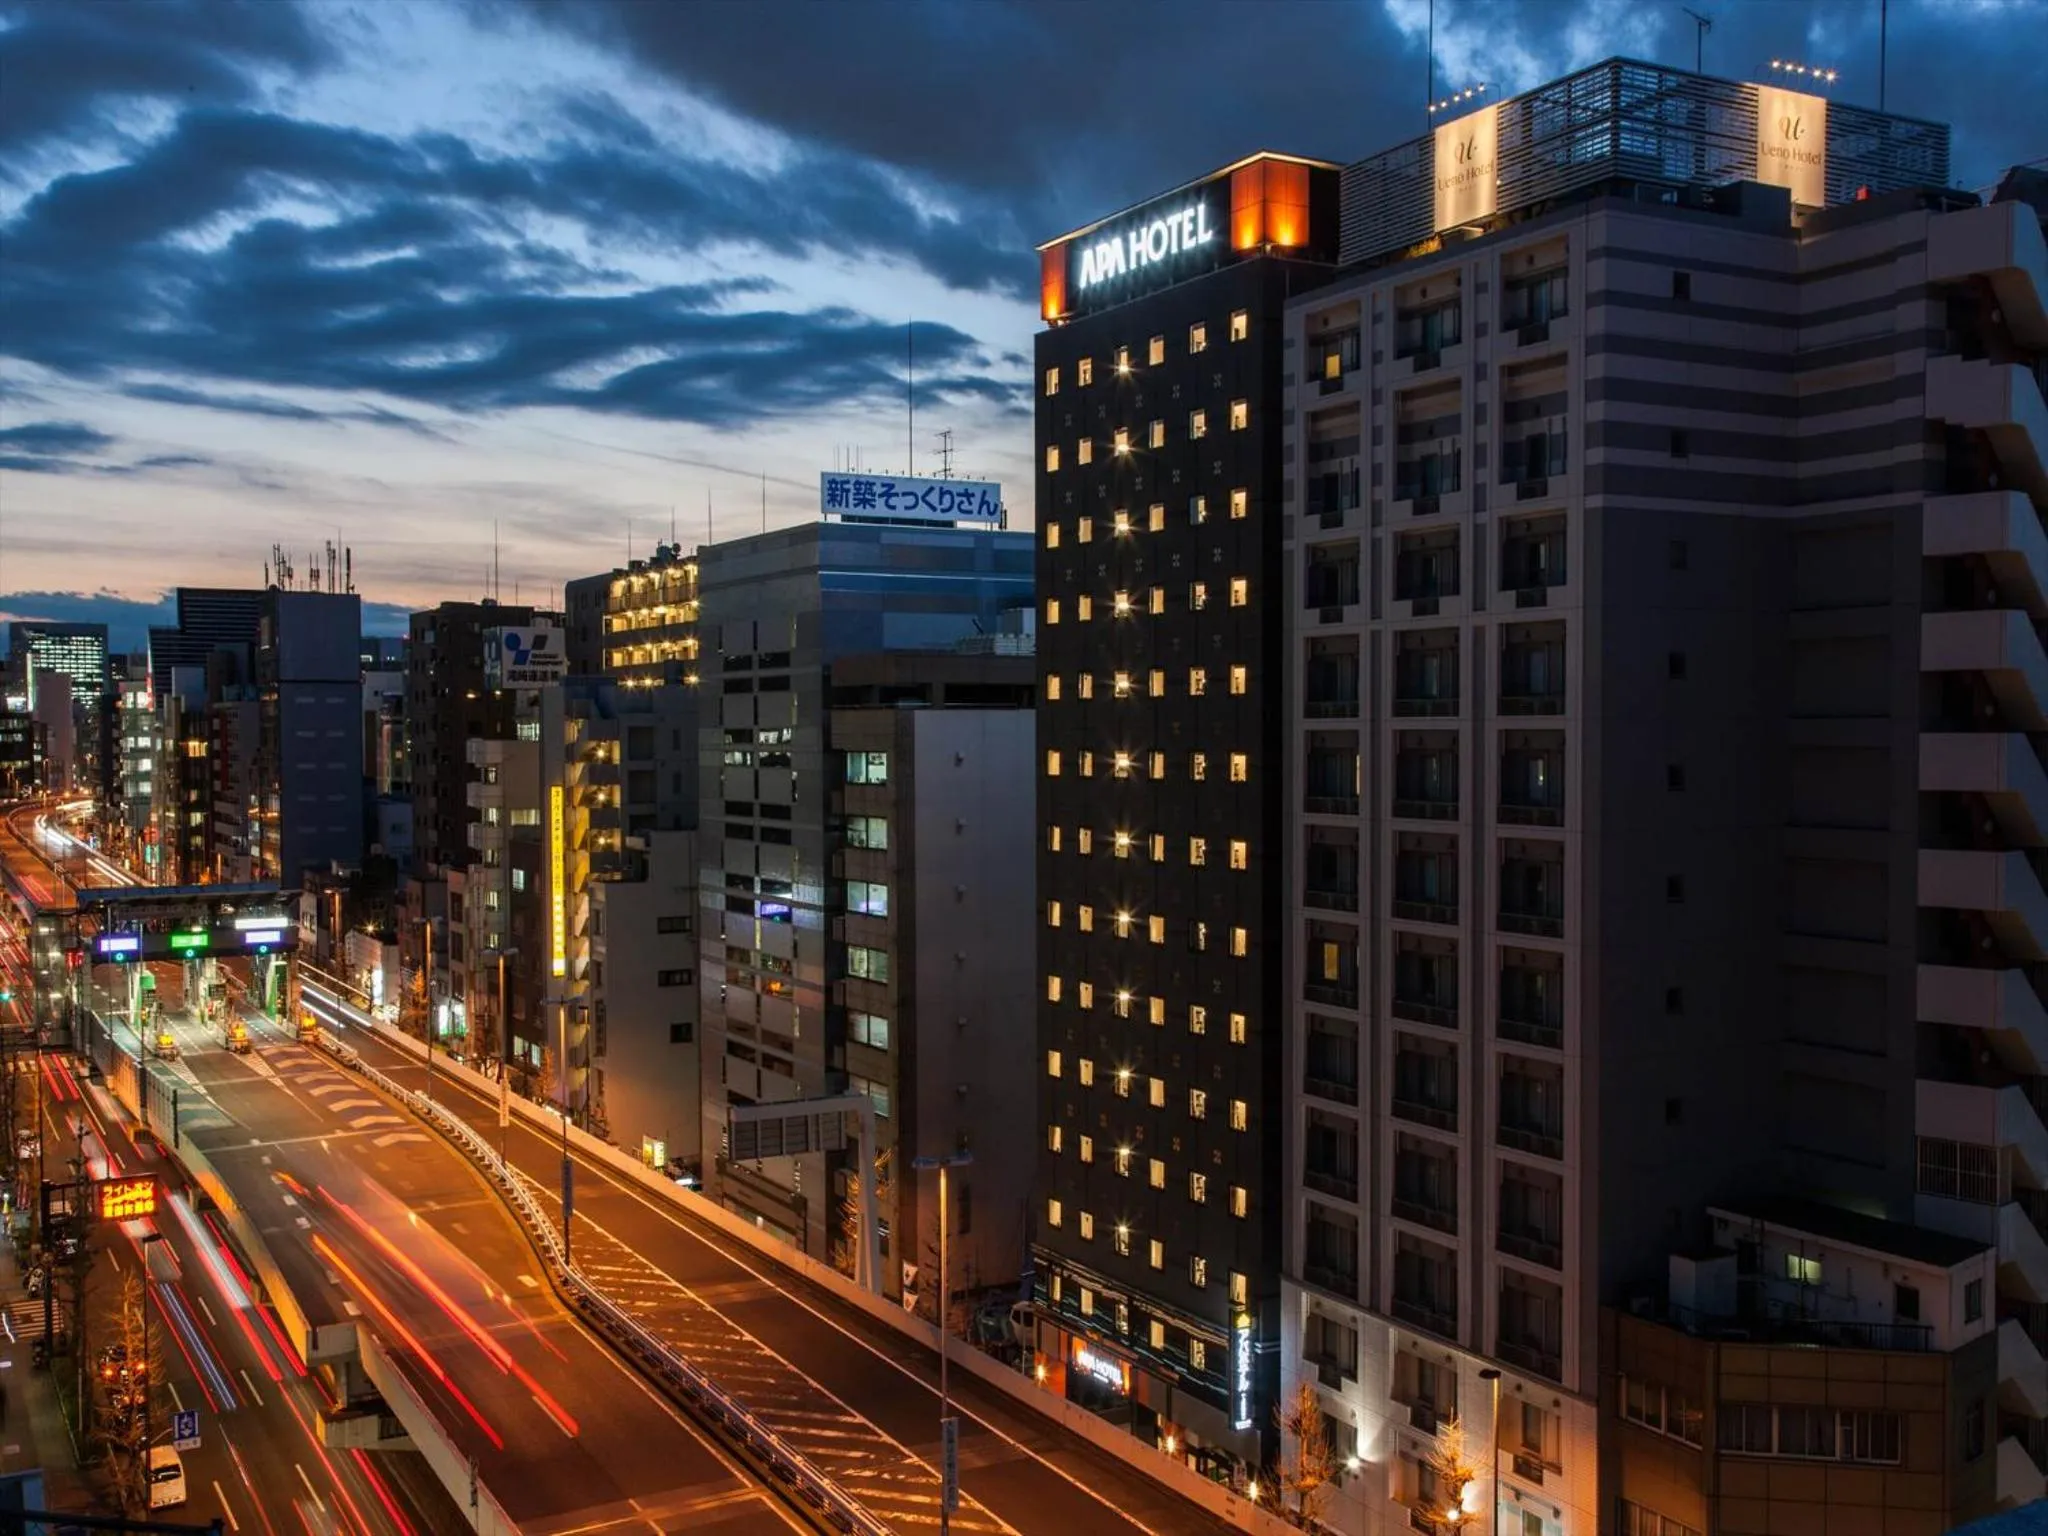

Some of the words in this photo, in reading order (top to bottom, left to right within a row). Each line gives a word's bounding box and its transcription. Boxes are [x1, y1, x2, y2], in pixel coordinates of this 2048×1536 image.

[1761, 141, 1790, 160] Ueno
[1793, 147, 1822, 165] Hotel
[1438, 172, 1465, 191] Ueno
[1467, 160, 1494, 181] Hotel
[1079, 238, 1126, 289] APA
[1129, 203, 1213, 270] HOTEL
[827, 478, 999, 517] 新築そっくりさん
